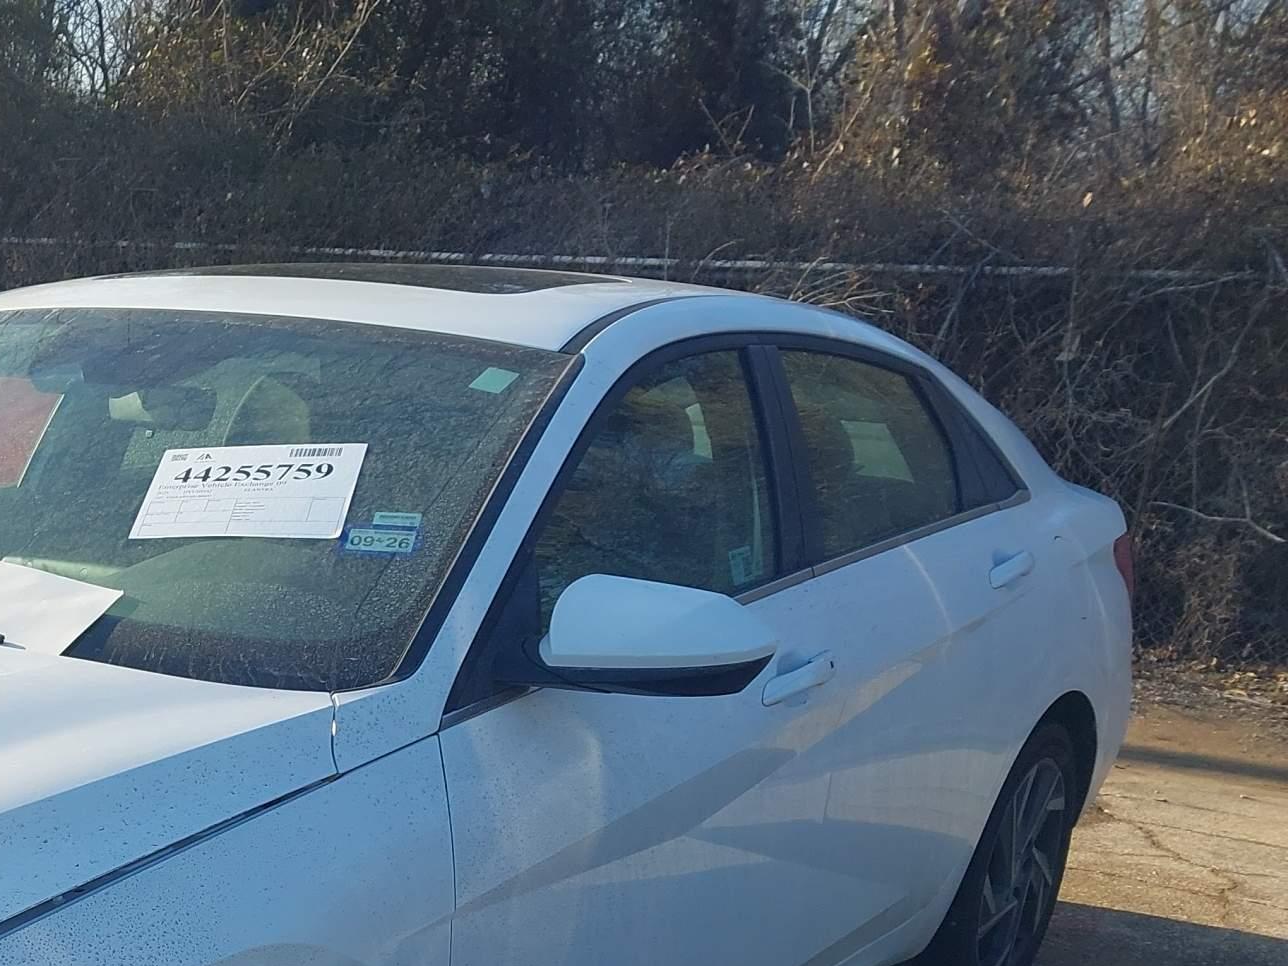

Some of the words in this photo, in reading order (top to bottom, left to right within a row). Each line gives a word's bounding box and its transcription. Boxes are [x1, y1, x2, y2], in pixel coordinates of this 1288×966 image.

[173, 462, 334, 483] 44255759
[350, 535, 375, 547] 09
[385, 537, 410, 549] 26
